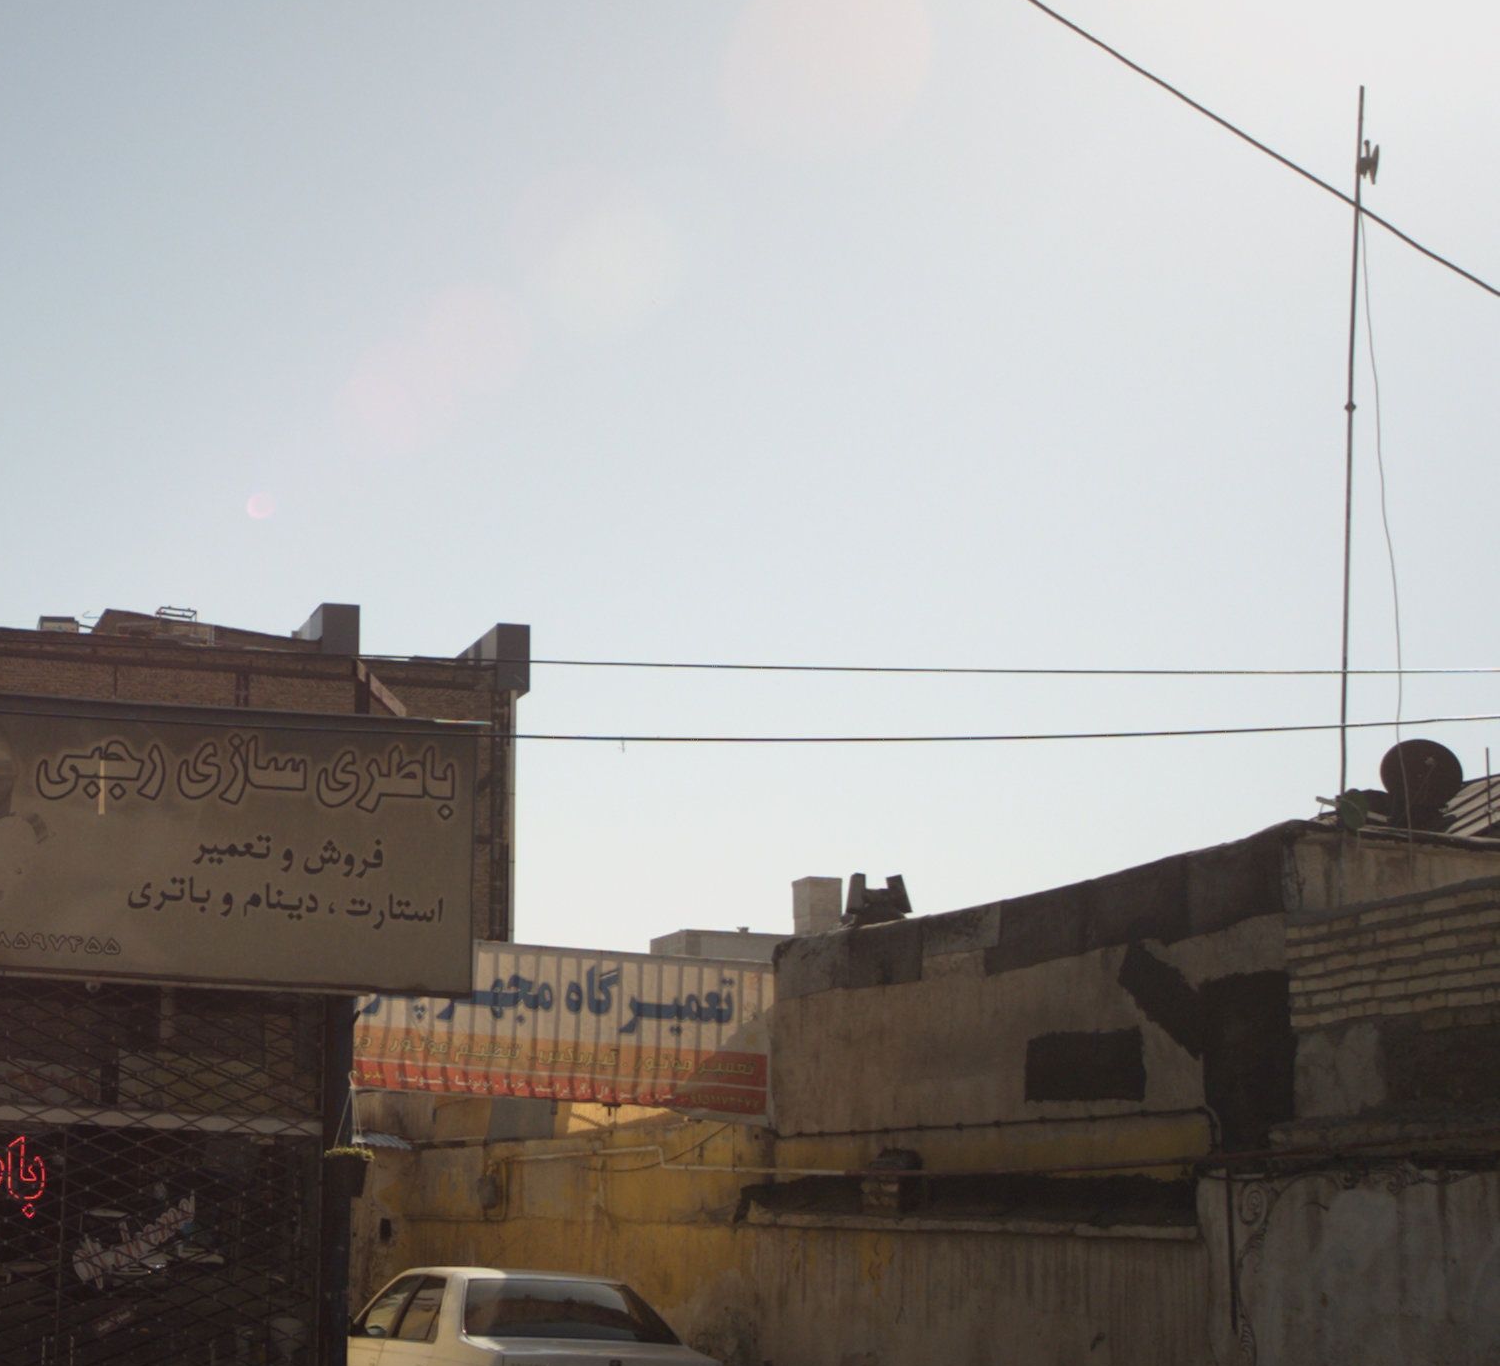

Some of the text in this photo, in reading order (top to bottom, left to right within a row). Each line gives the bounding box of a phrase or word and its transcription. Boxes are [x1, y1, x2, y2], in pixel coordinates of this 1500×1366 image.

[35, 733, 457, 821] باطری سازی رجبی
[190, 833, 385, 877] فروش و تعمیر
[126, 874, 213, 916] باتری
[219, 891, 237, 920] و
[241, 881, 321, 919] دینام
[347, 891, 445, 928] استارت
